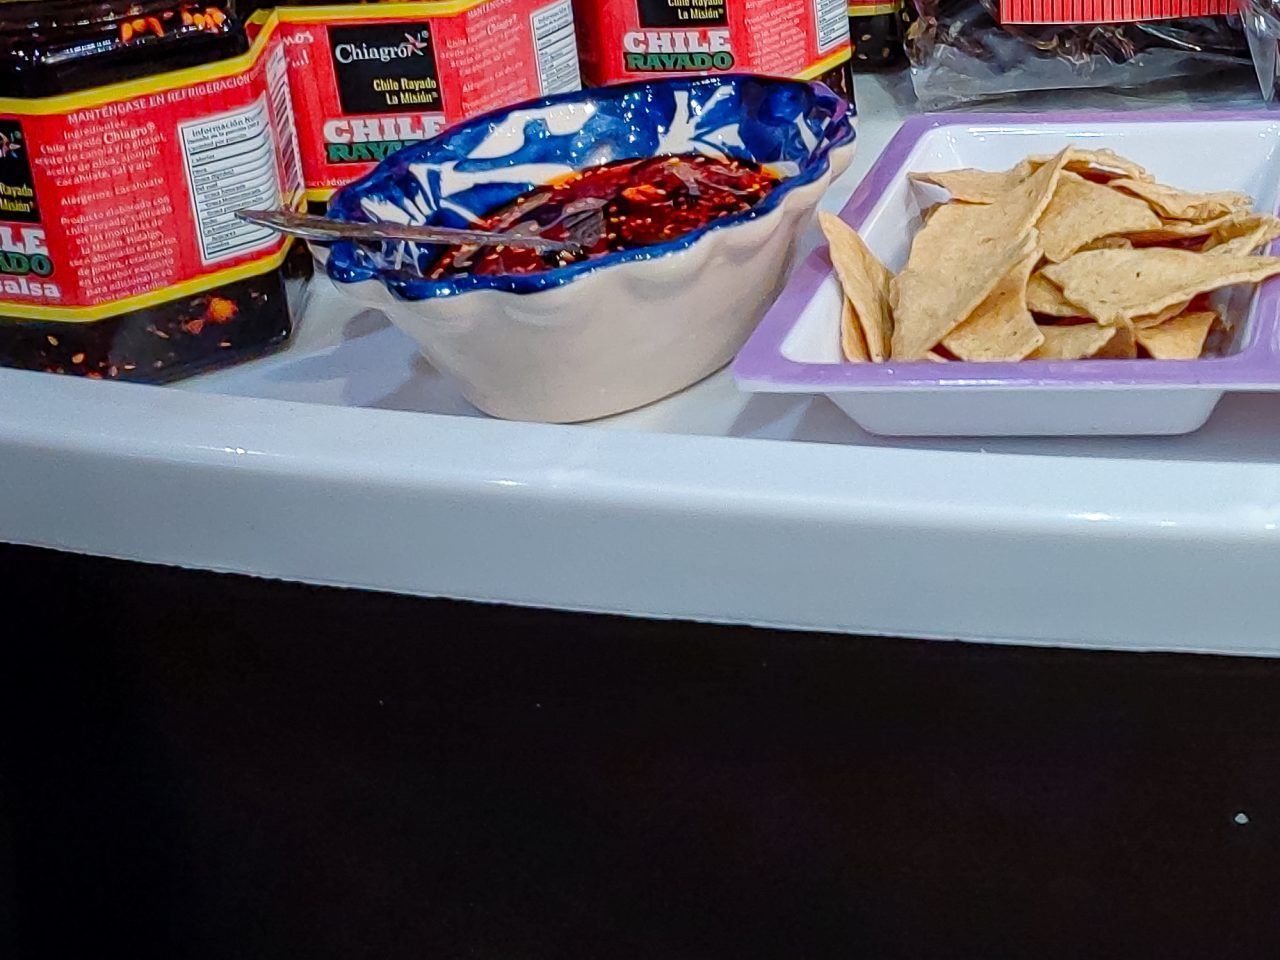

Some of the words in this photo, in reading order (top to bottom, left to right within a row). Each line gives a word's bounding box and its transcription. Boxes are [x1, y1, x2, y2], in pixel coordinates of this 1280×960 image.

[677, 7, 690, 20] La
[622, 30, 733, 54] CHILE
[334, 42, 408, 65] Chiagro
[624, 51, 735, 71] RAYADO
[373, 78, 400, 92] Chile
[400, 76, 437, 91] Rayado
[385, 92, 399, 106] La
[322, 115, 446, 144] CHILE
